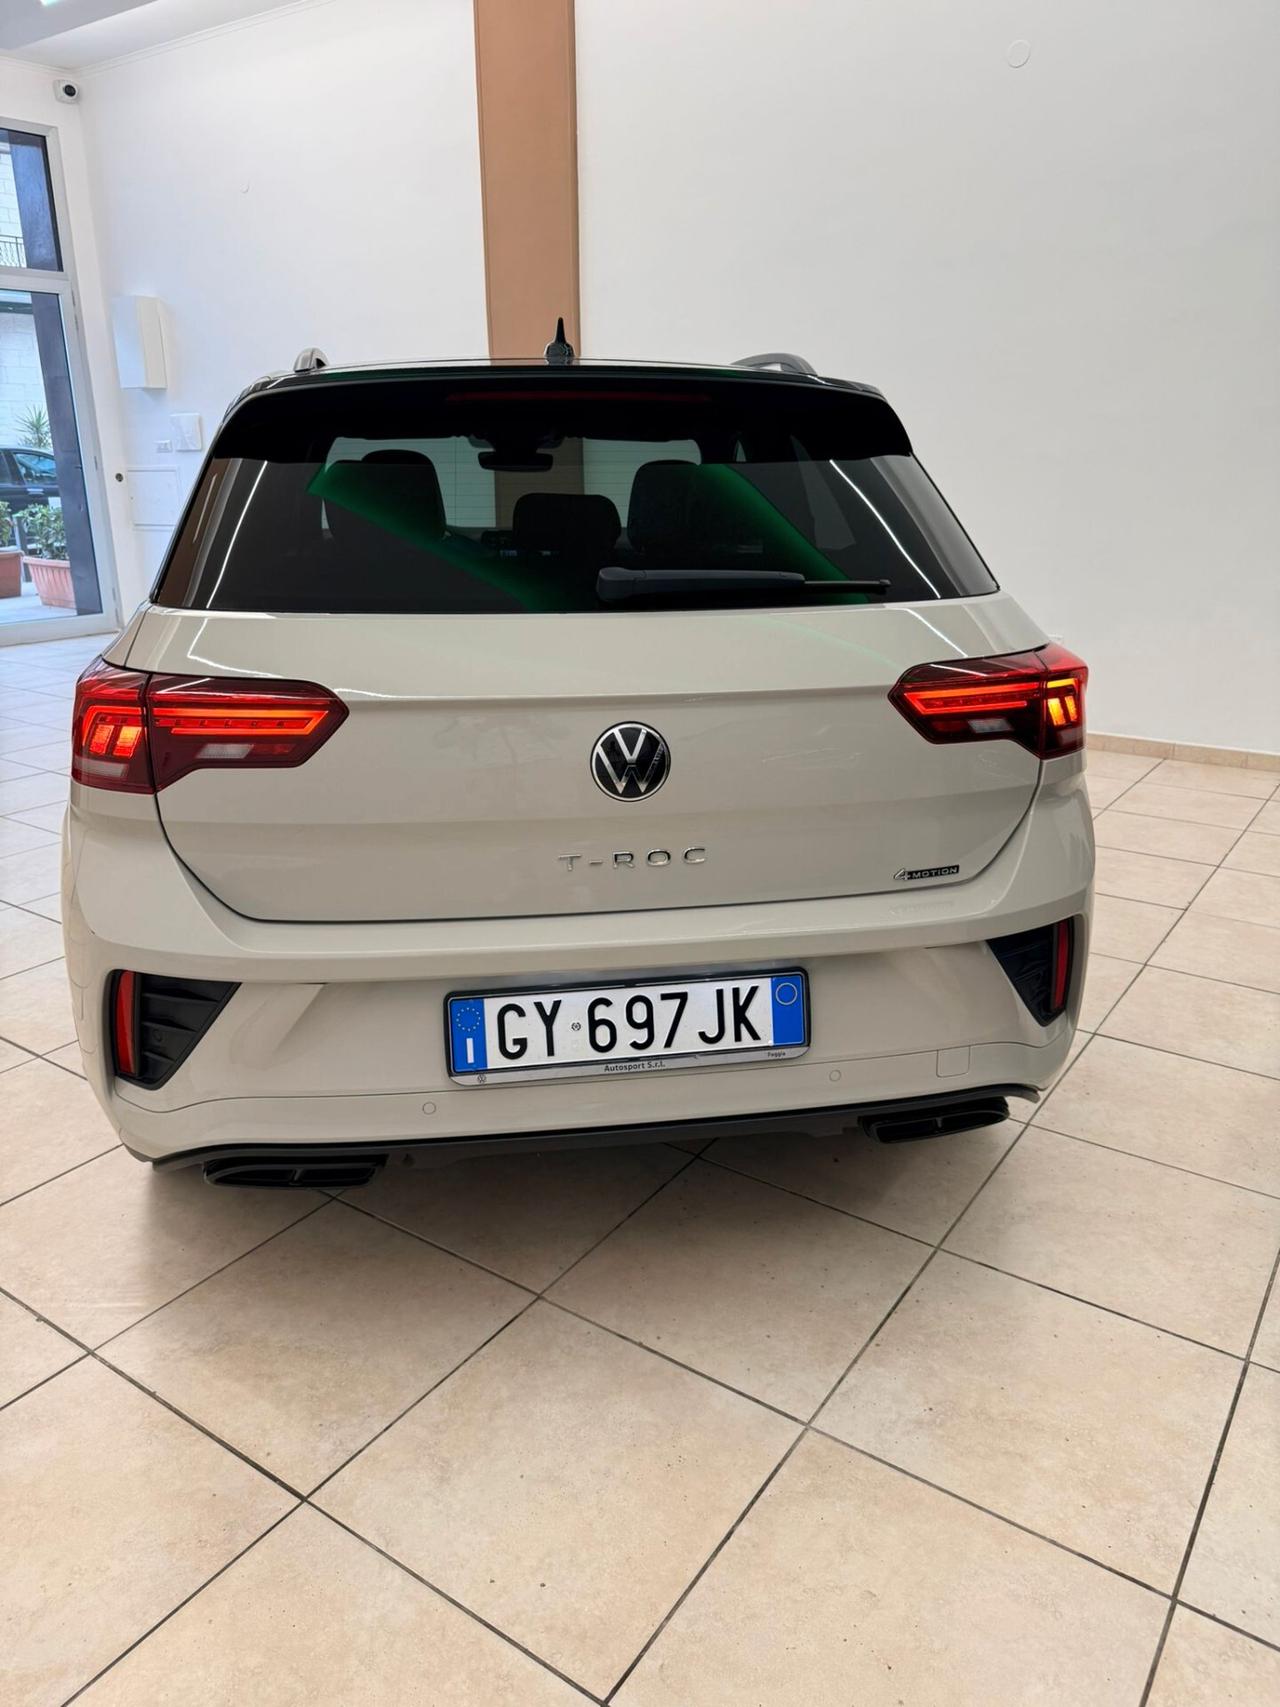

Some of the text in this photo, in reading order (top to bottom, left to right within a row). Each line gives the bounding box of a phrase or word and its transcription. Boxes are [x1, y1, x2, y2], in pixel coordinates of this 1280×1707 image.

[592, 723, 670, 801] VW
[558, 847, 707, 872] T-ROC
[893, 865, 960, 881] 4MOTION
[497, 999, 562, 1060] GY
[466, 1038, 474, 1063] I
[604, 1063, 645, 1073] Autosport
